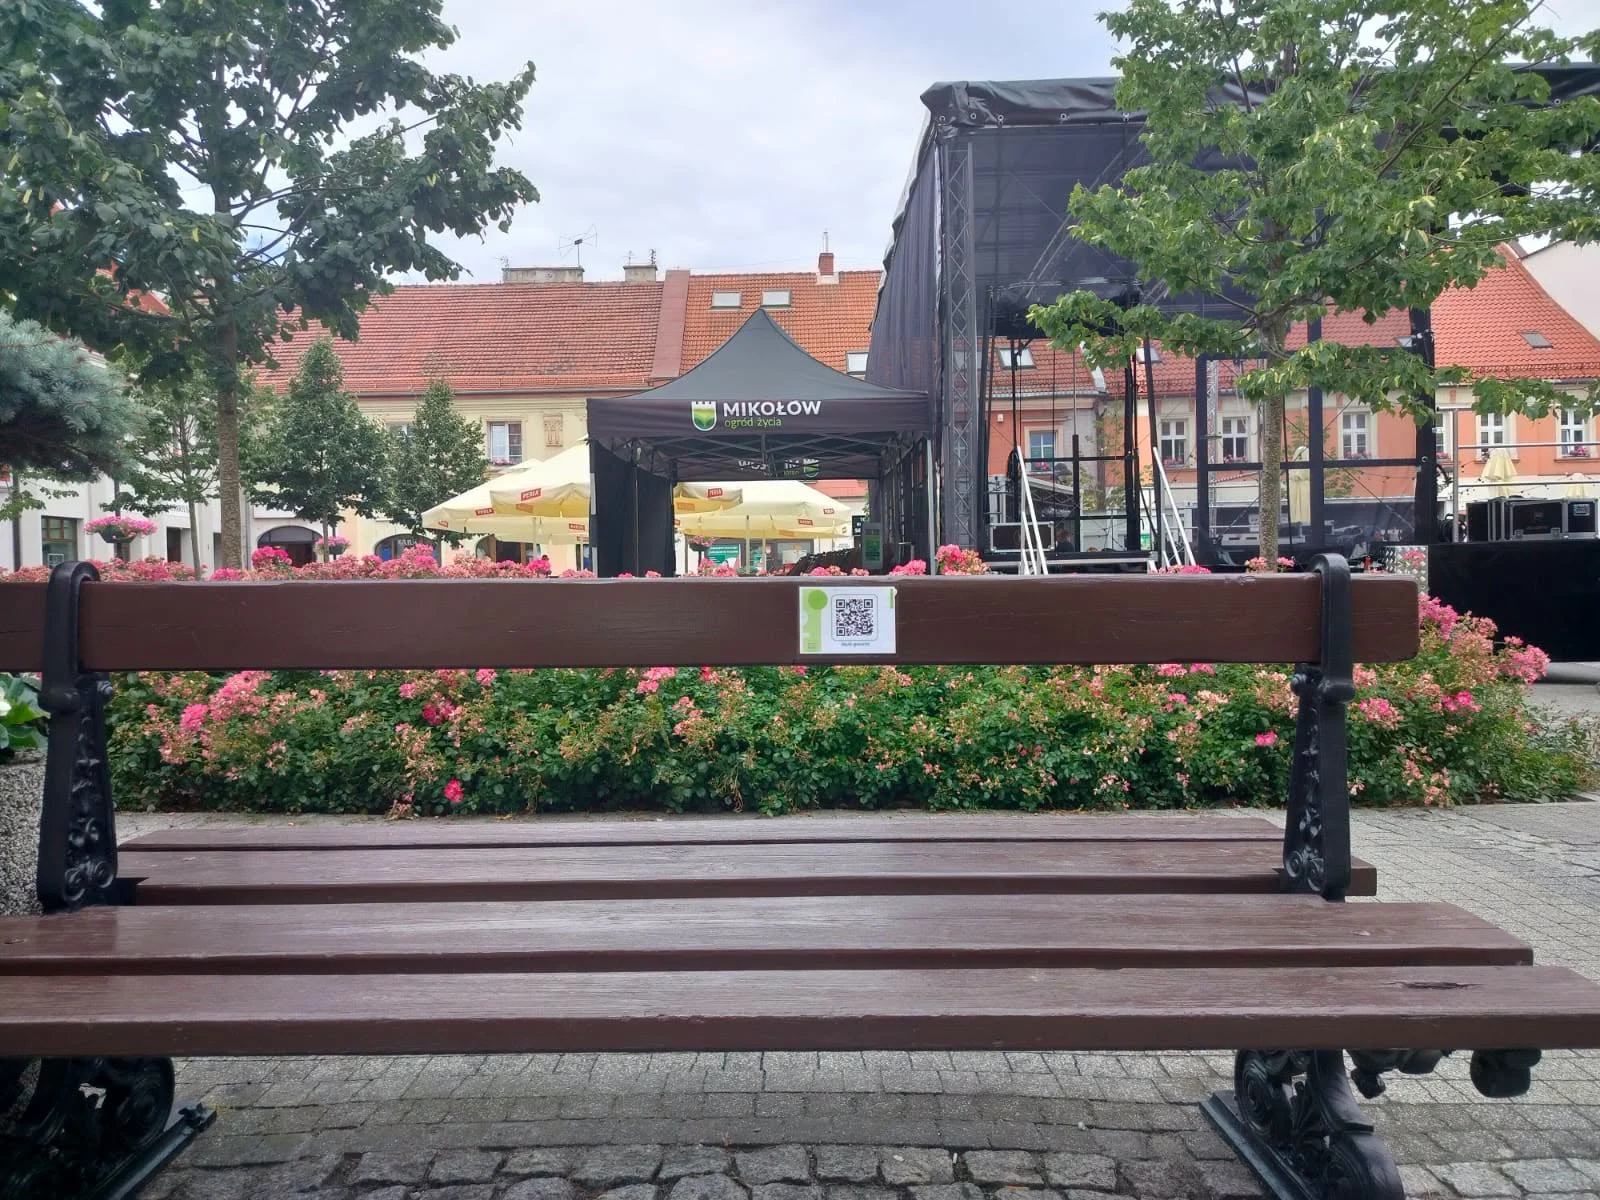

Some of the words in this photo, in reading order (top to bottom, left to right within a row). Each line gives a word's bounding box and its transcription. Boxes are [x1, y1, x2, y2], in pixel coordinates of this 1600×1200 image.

[723, 400, 822, 417] MIKOŁÓW
[724, 417, 754, 429] ogród
[757, 417, 782, 428] życia
